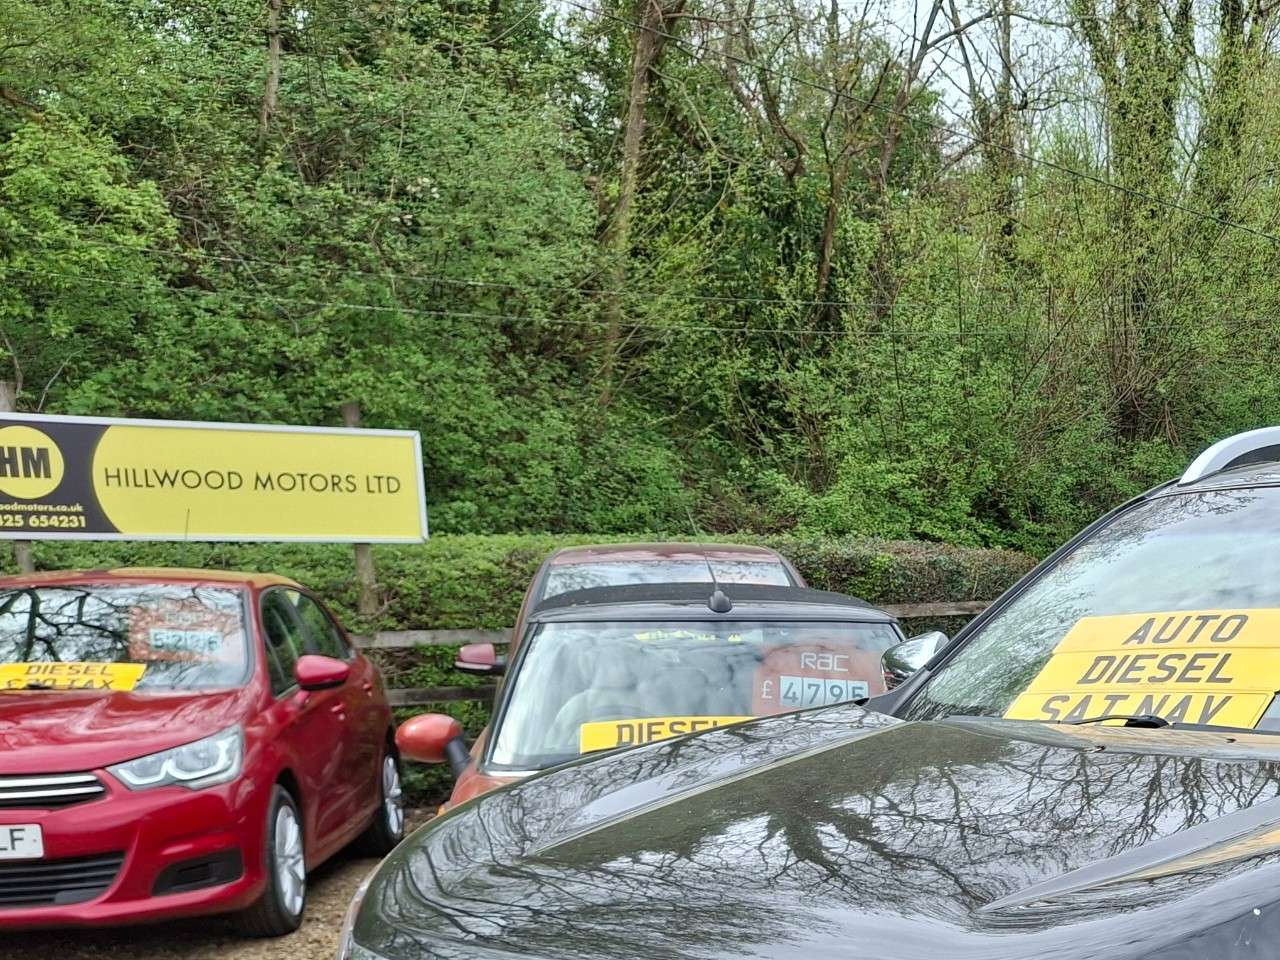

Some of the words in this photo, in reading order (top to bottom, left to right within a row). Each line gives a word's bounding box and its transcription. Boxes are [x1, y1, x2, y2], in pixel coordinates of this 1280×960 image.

[0, 446, 52, 478] HM
[104, 467, 243, 490] HILLWOOD
[254, 472, 357, 493] MOTORS
[366, 475, 401, 494] LTD
[0, 514, 24, 528] 25
[29, 515, 87, 528] 654231
[1122, 614, 1249, 645] AUTO
[25, 665, 115, 676] DIESEL
[1077, 653, 1236, 685] DIESEL
[1035, 694, 1129, 722] SAT
[1133, 694, 1233, 726] NAV
[616, 720, 729, 747] DIES
